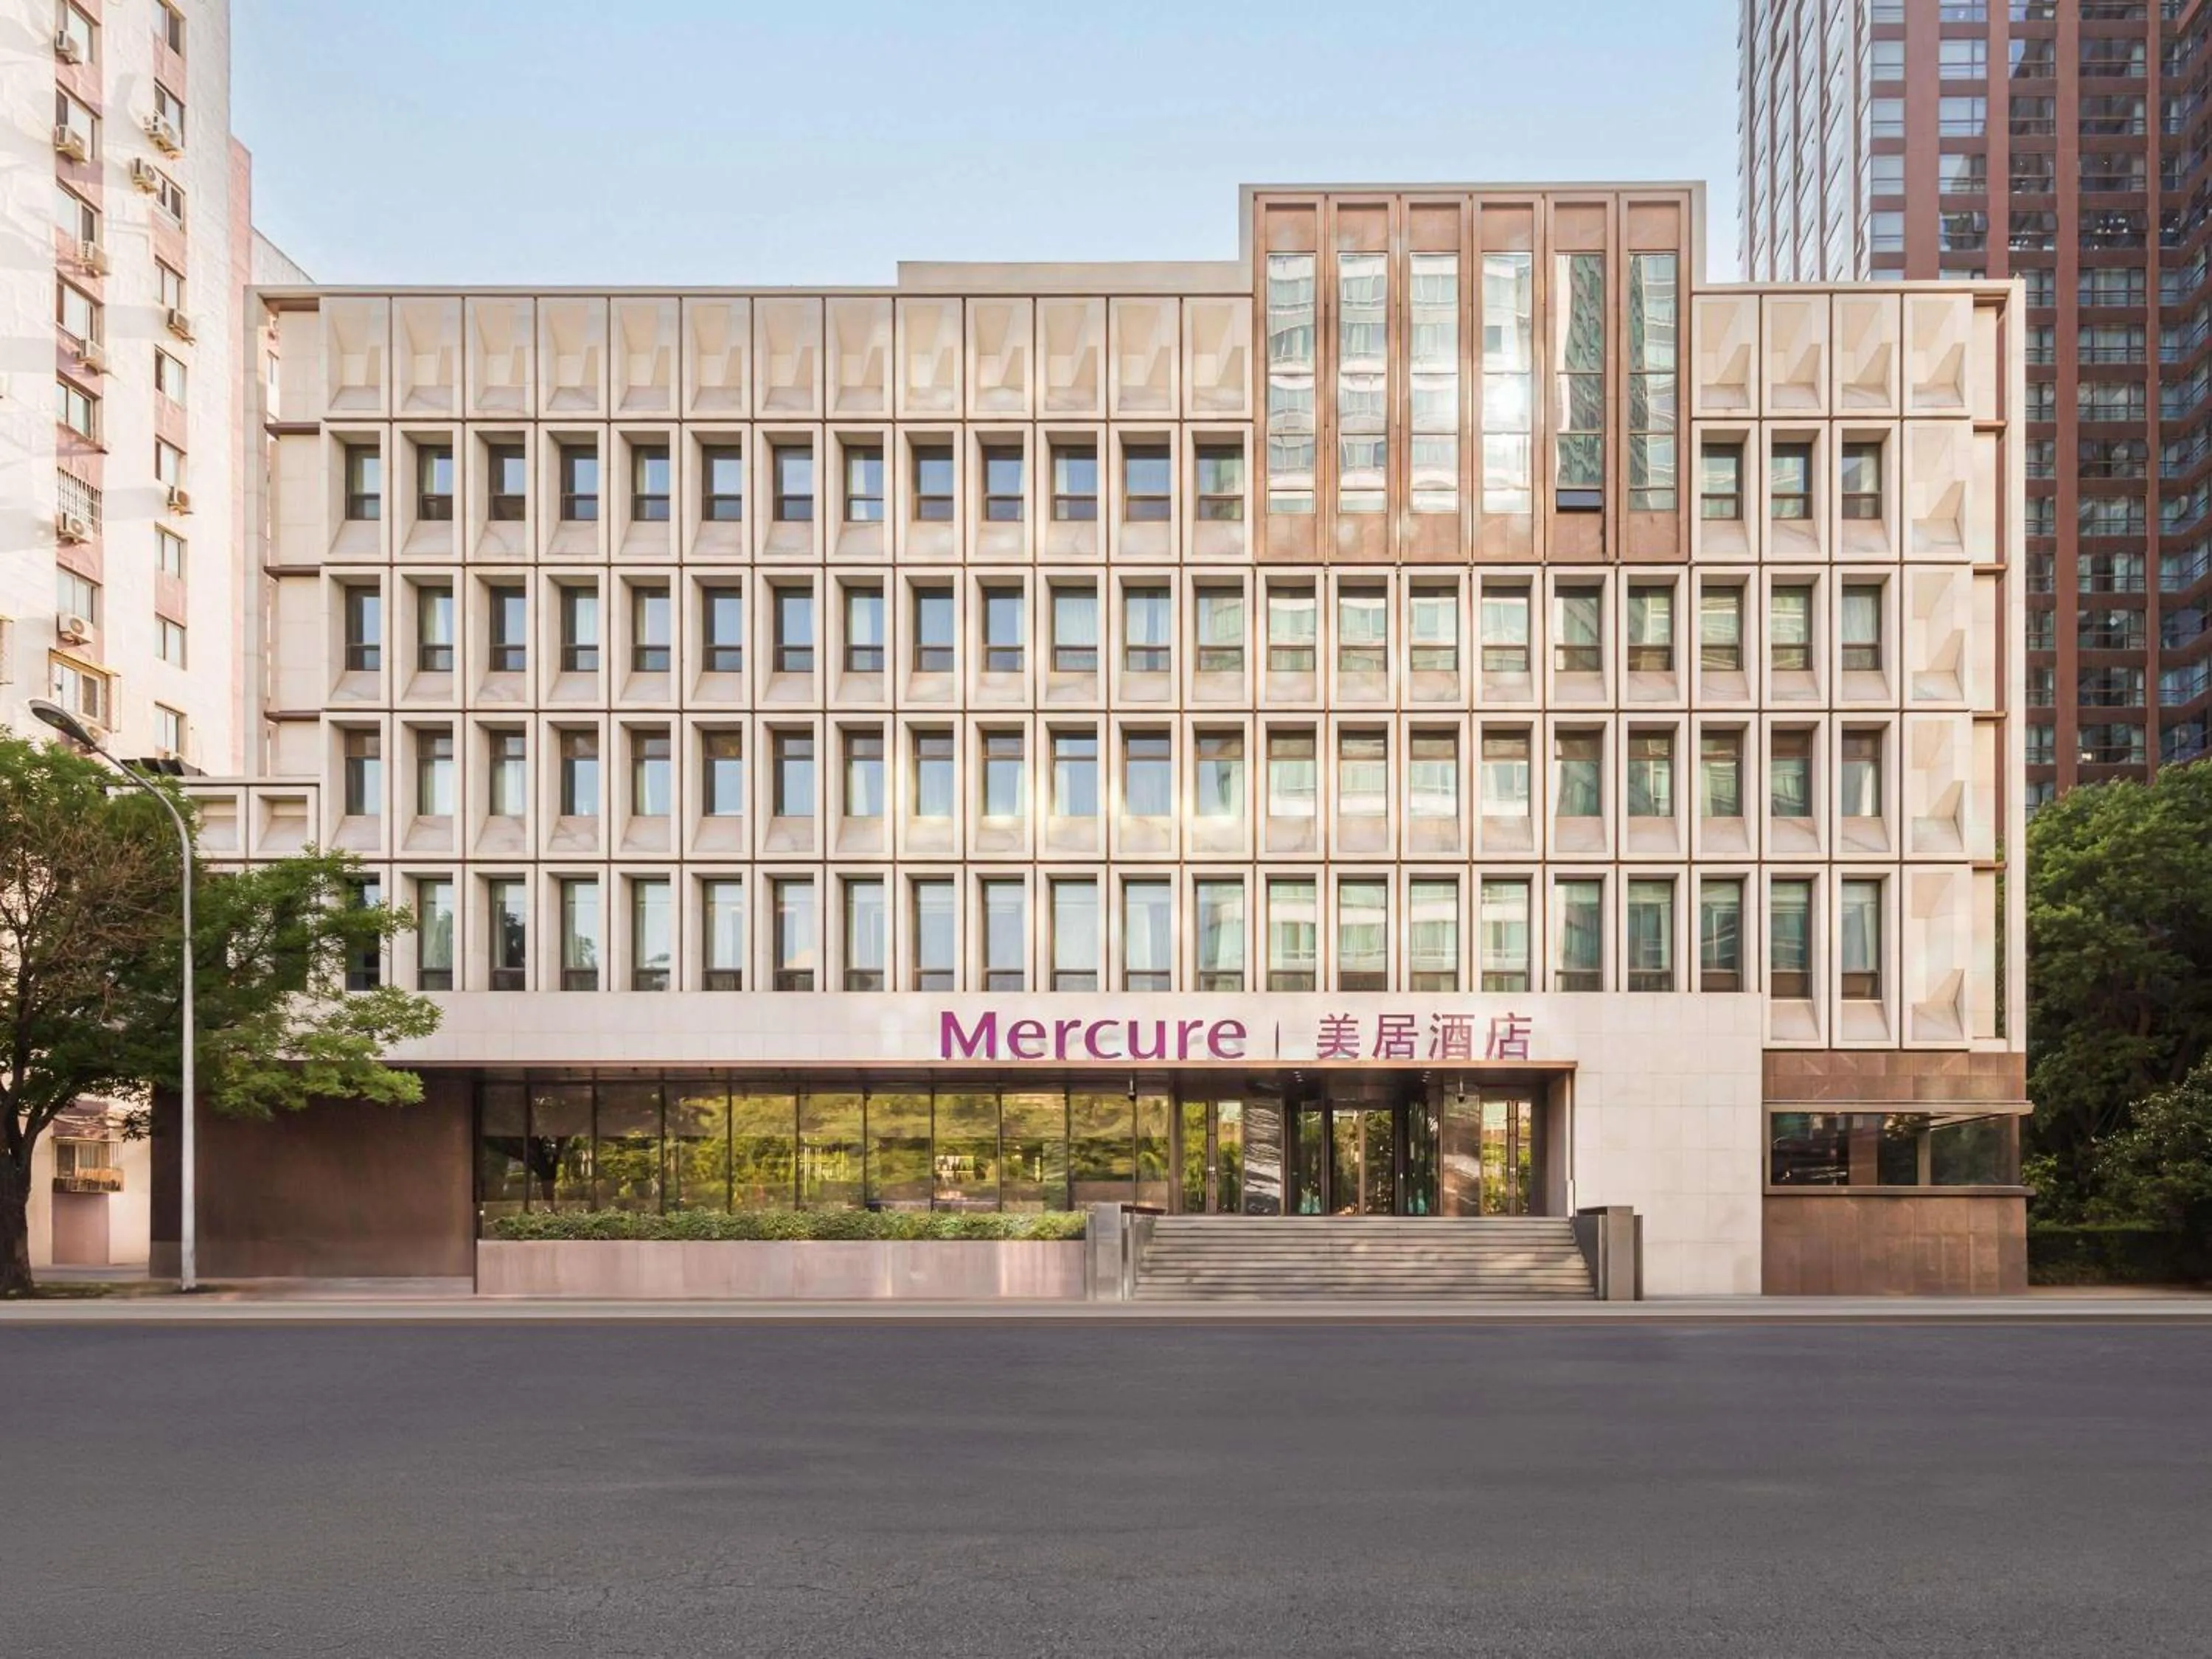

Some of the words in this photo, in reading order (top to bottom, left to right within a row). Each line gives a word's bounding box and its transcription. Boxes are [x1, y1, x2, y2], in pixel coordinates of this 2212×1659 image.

[940, 1011, 1247, 1060] Mercure
[1316, 1012, 1532, 1060] 美居酒店
